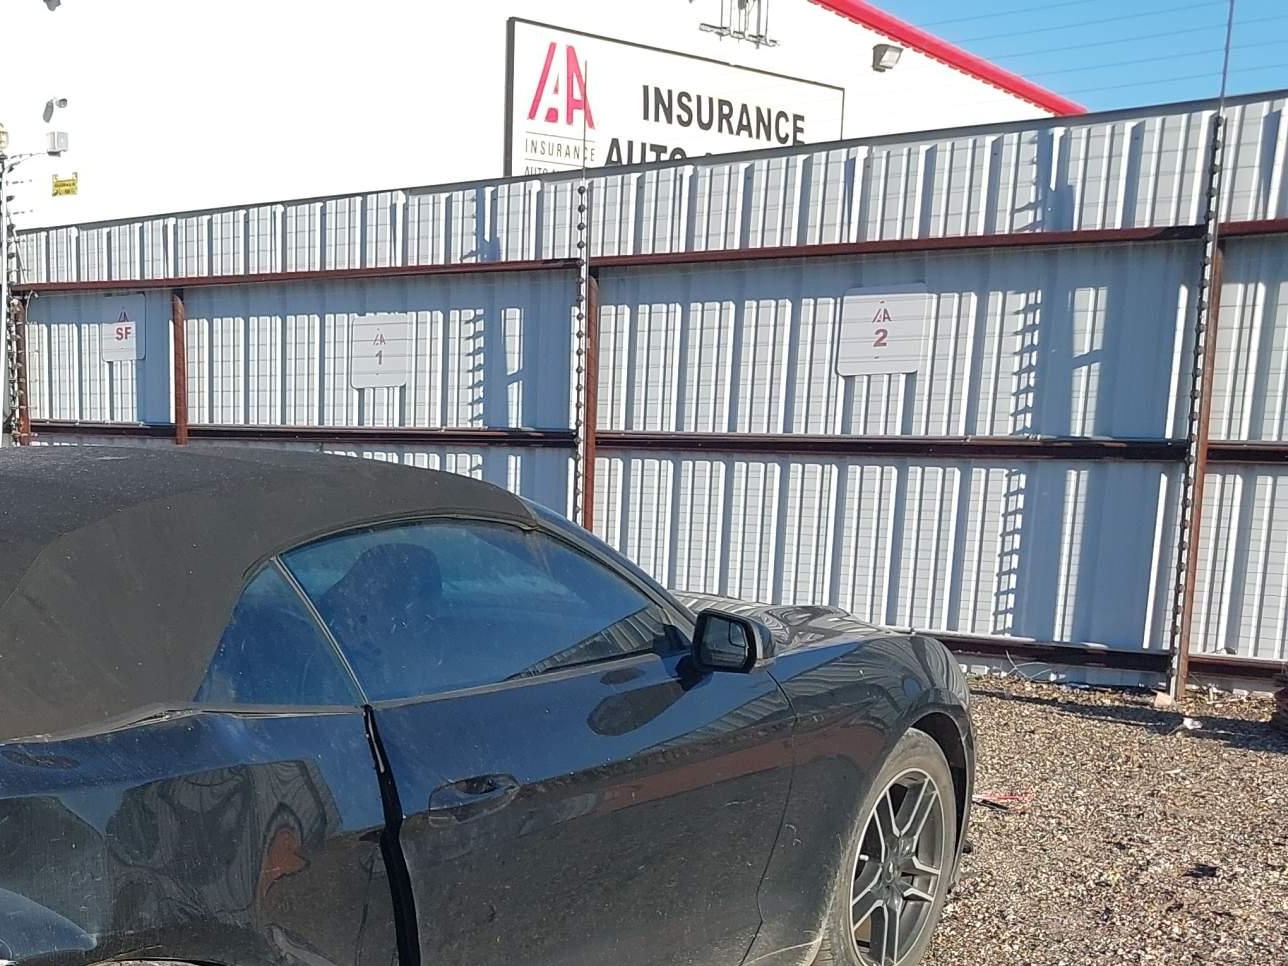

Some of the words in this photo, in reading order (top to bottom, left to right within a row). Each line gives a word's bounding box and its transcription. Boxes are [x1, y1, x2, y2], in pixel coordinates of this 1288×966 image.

[642, 84, 806, 145] INSURANCE
[525, 138, 596, 162] INSURANCE
[116, 326, 132, 341] SF
[873, 328, 888, 347] 2
[375, 350, 383, 365] 1
